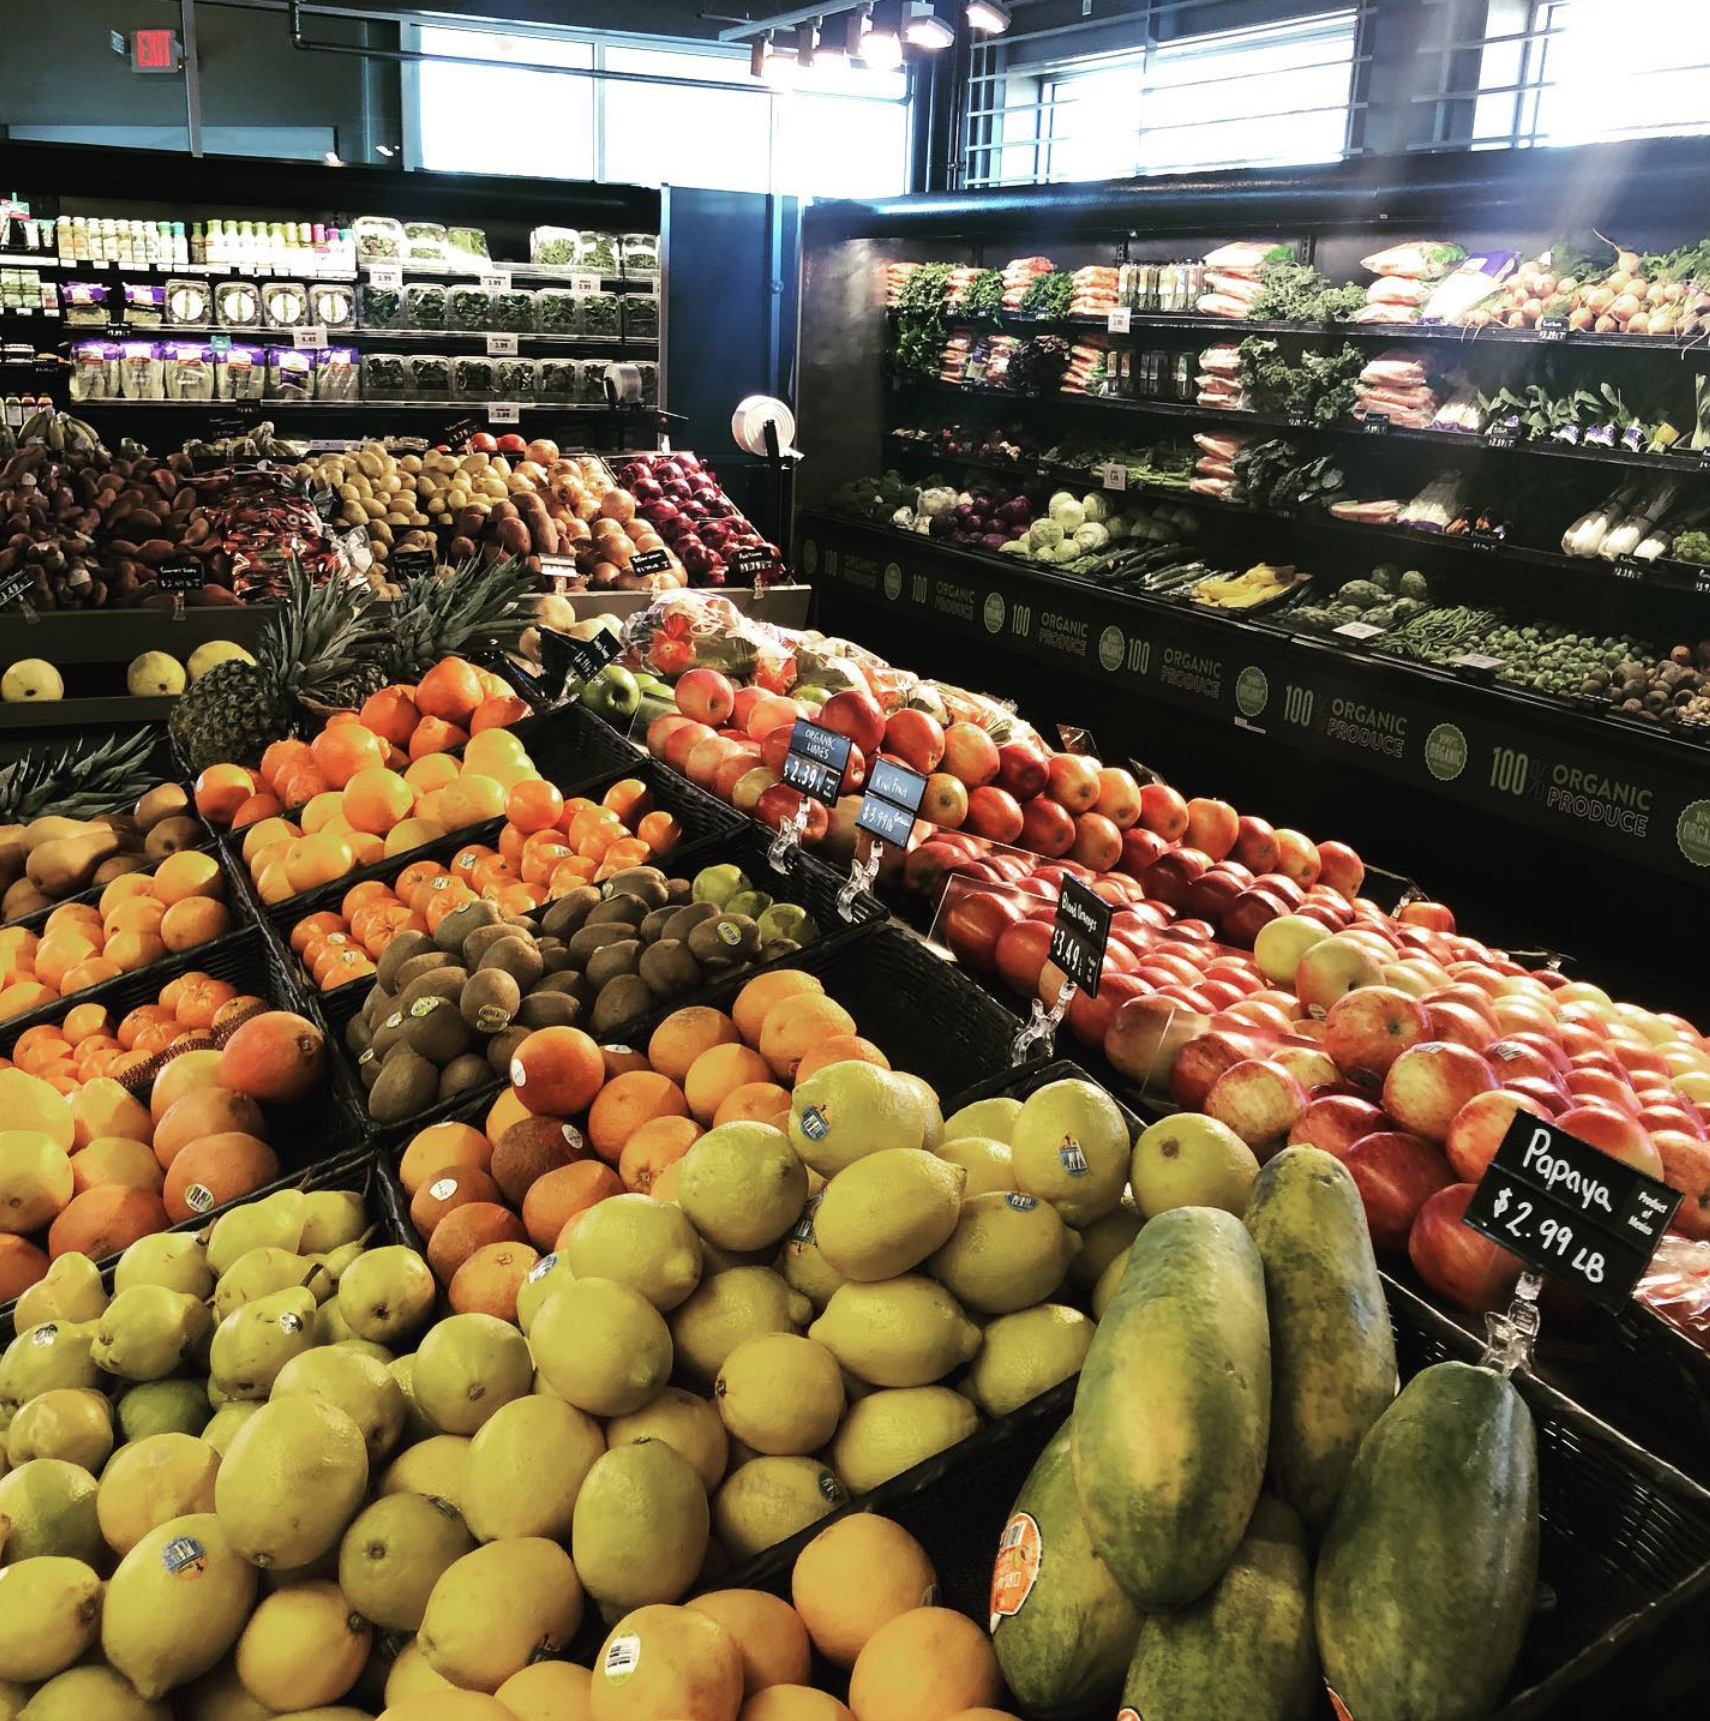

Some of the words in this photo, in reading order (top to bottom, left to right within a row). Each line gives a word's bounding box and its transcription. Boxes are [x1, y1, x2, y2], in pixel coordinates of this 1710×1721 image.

[137, 30, 171, 67] EXIT
[936, 579, 976, 603] ORGANIC
[1011, 603, 1031, 638] 100
[1041, 611, 1089, 639] ORGANIC
[1038, 628, 1088, 657] PRODUCE
[1127, 637, 1150, 676] 100
[1163, 647, 1223, 679] ORGANIC
[1160, 664, 1221, 699] PRODUCE
[1331, 697, 1408, 736] ORGANIC
[804, 728, 836, 751] ORGANIC
[1327, 717, 1405, 759] PRODUCE
[1429, 742, 1462, 768] ORGANIC
[1552, 763, 1653, 812] ORGANIC
[1547, 786, 1648, 838] PRODUCE
[1061, 891, 1077, 918] Blood
[1053, 929, 1080, 971] $3.49
[1523, 1128, 1613, 1213] Papaya
[1493, 1187, 1573, 1256] $2.99
[1571, 1246, 1605, 1284] LB
